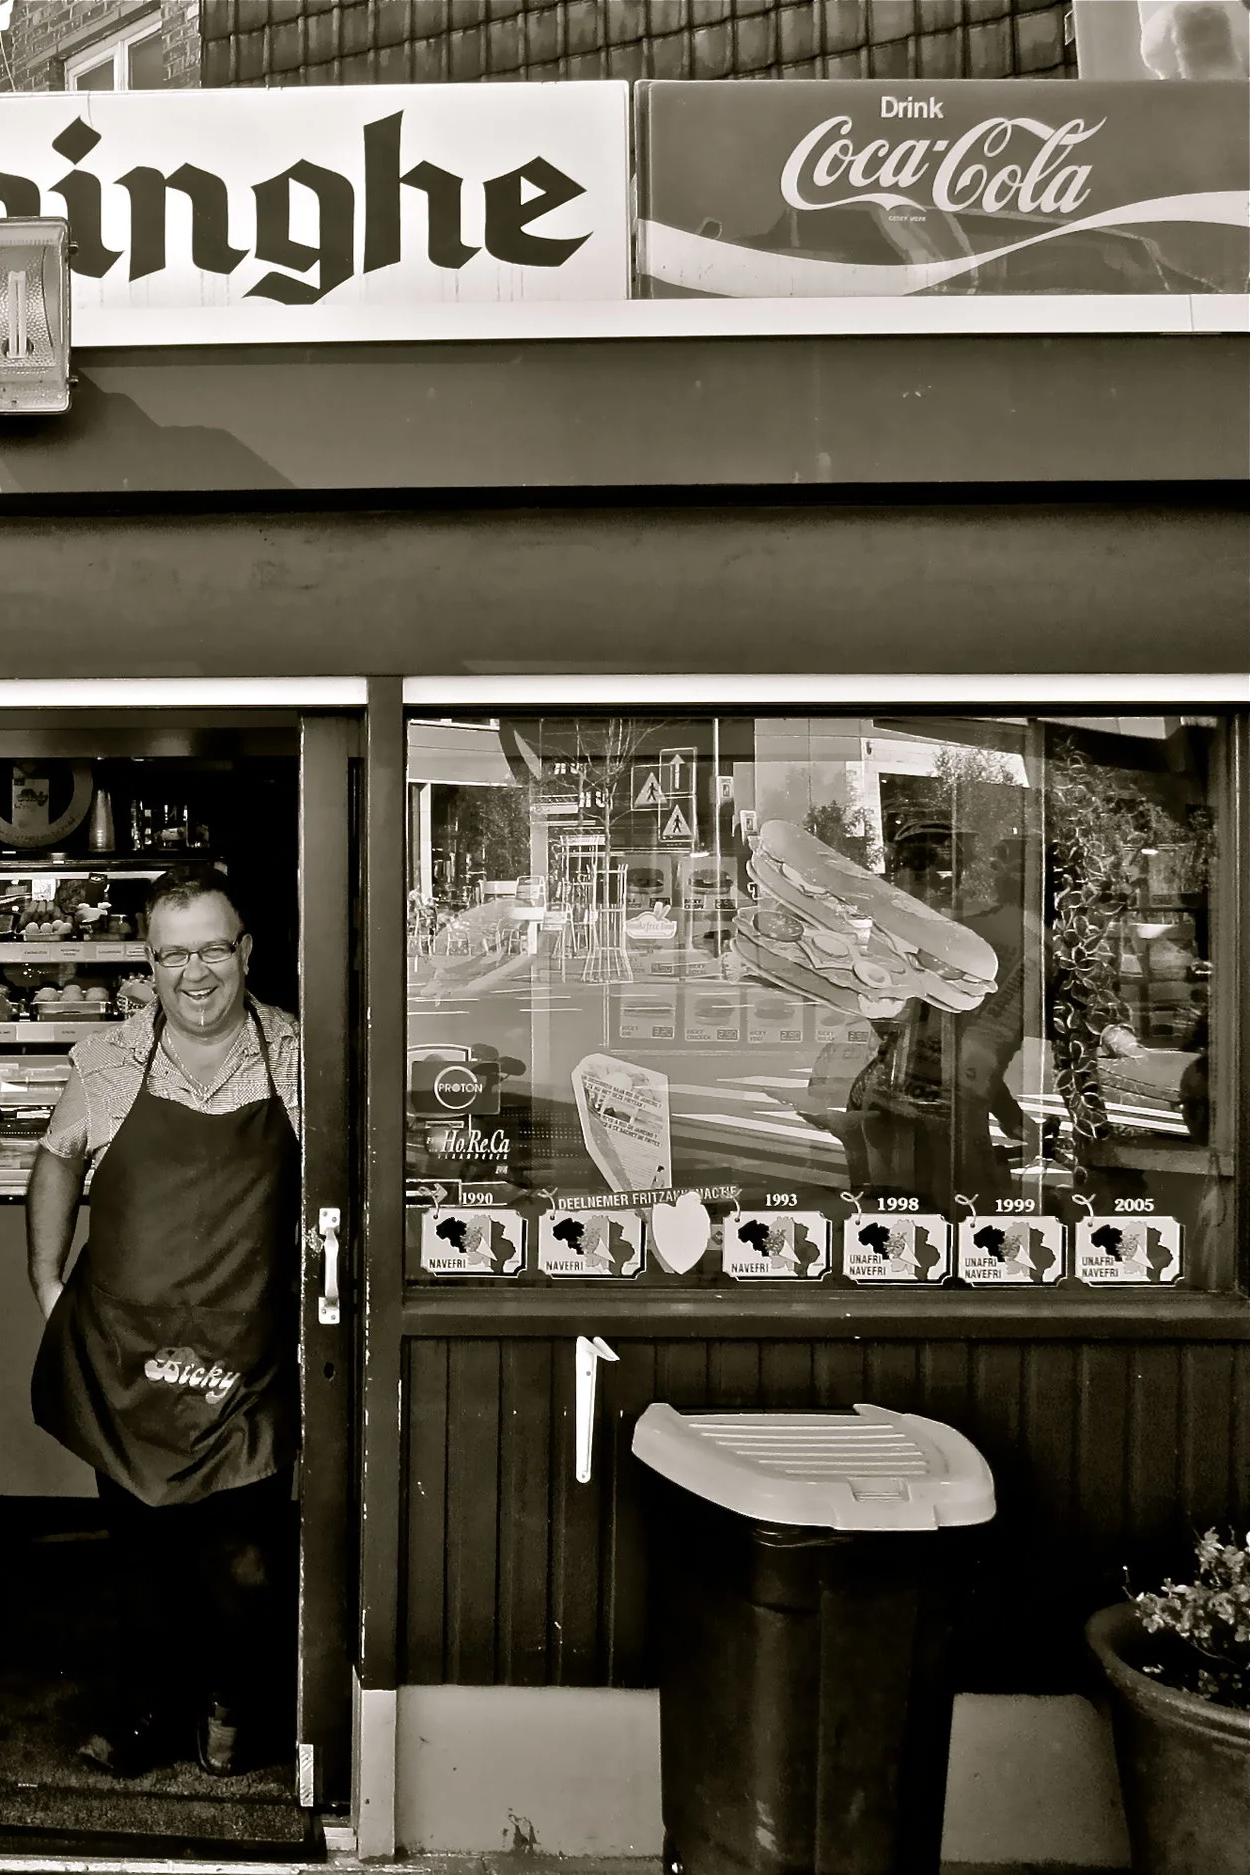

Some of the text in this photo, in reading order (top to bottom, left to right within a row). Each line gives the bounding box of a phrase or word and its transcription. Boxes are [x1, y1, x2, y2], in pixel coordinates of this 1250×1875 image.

[880, 95, 944, 119] Drink
[780, 115, 1108, 213] Coca-Cola
[438, 1083, 483, 1093] PROTON
[440, 1129, 510, 1153] Ho.Re.Ca
[462, 1192, 494, 1205] 1990
[558, 1192, 629, 1210] DEELNEMER
[765, 1193, 798, 1206] 1993
[877, 1197, 920, 1211] 1998
[995, 1199, 1035, 1212] 1999
[1114, 1198, 1154, 1212] 2005
[429, 1258, 466, 1269] NAVEFRI
[850, 1254, 882, 1265] UNAFRI
[965, 1257, 997, 1267] UNAFRI
[1082, 1256, 1114, 1266] UNAFRI
[546, 1261, 584, 1271] NAVEFRI
[731, 1263, 769, 1273] NAVEFRI
[850, 1266, 886, 1276] NAVEFRI
[965, 1268, 1001, 1279] NAVEFRI
[1082, 1267, 1118, 1278] NAVEFRI
